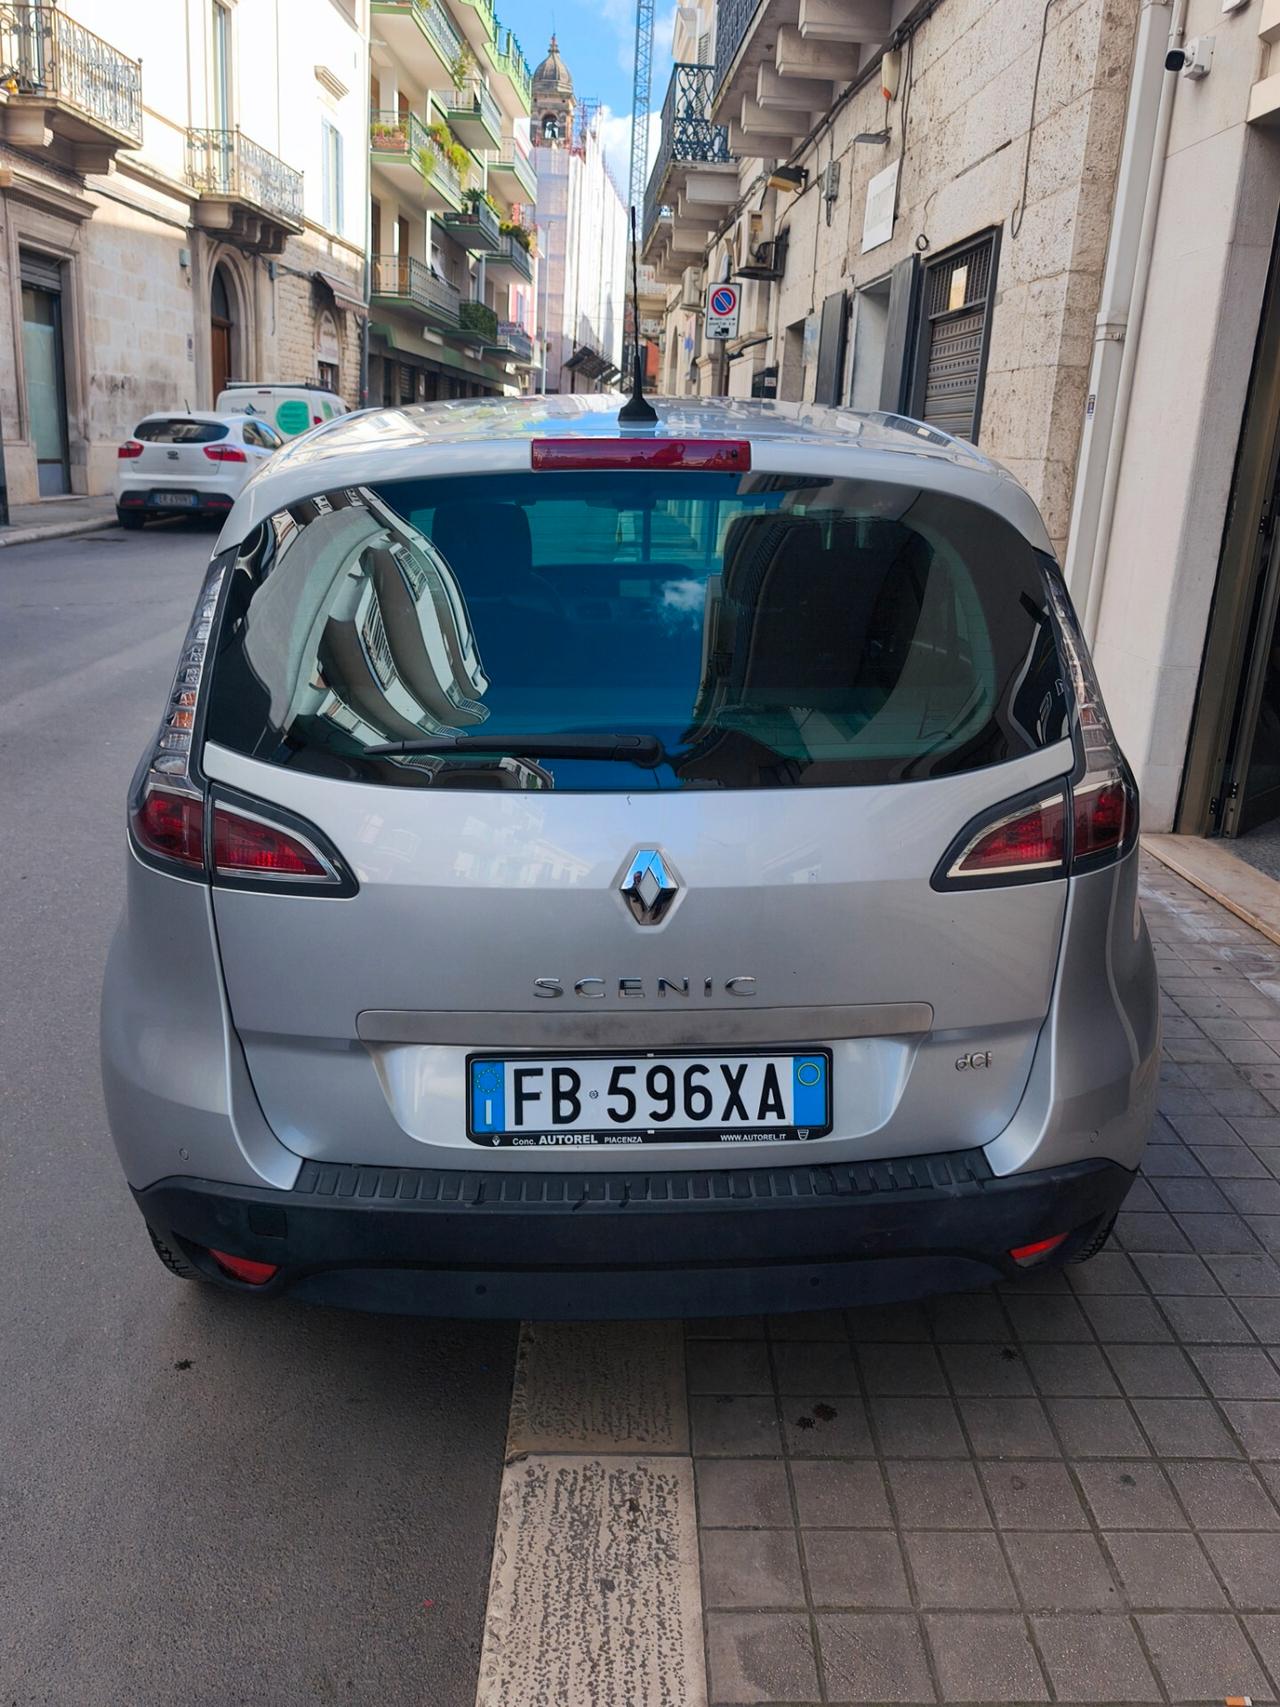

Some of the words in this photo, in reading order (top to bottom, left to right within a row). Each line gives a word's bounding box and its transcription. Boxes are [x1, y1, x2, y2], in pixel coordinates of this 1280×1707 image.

[533, 976, 757, 999] SCENIC
[513, 1067, 582, 1126] FB
[606, 1063, 787, 1123] 596XA
[512, 1137, 537, 1146] Conc.
[538, 1134, 598, 1145] AUTOREL
[603, 1135, 643, 1144] PIACENZA
[720, 1133, 787, 1142] WWW.AUTOREL.IT
